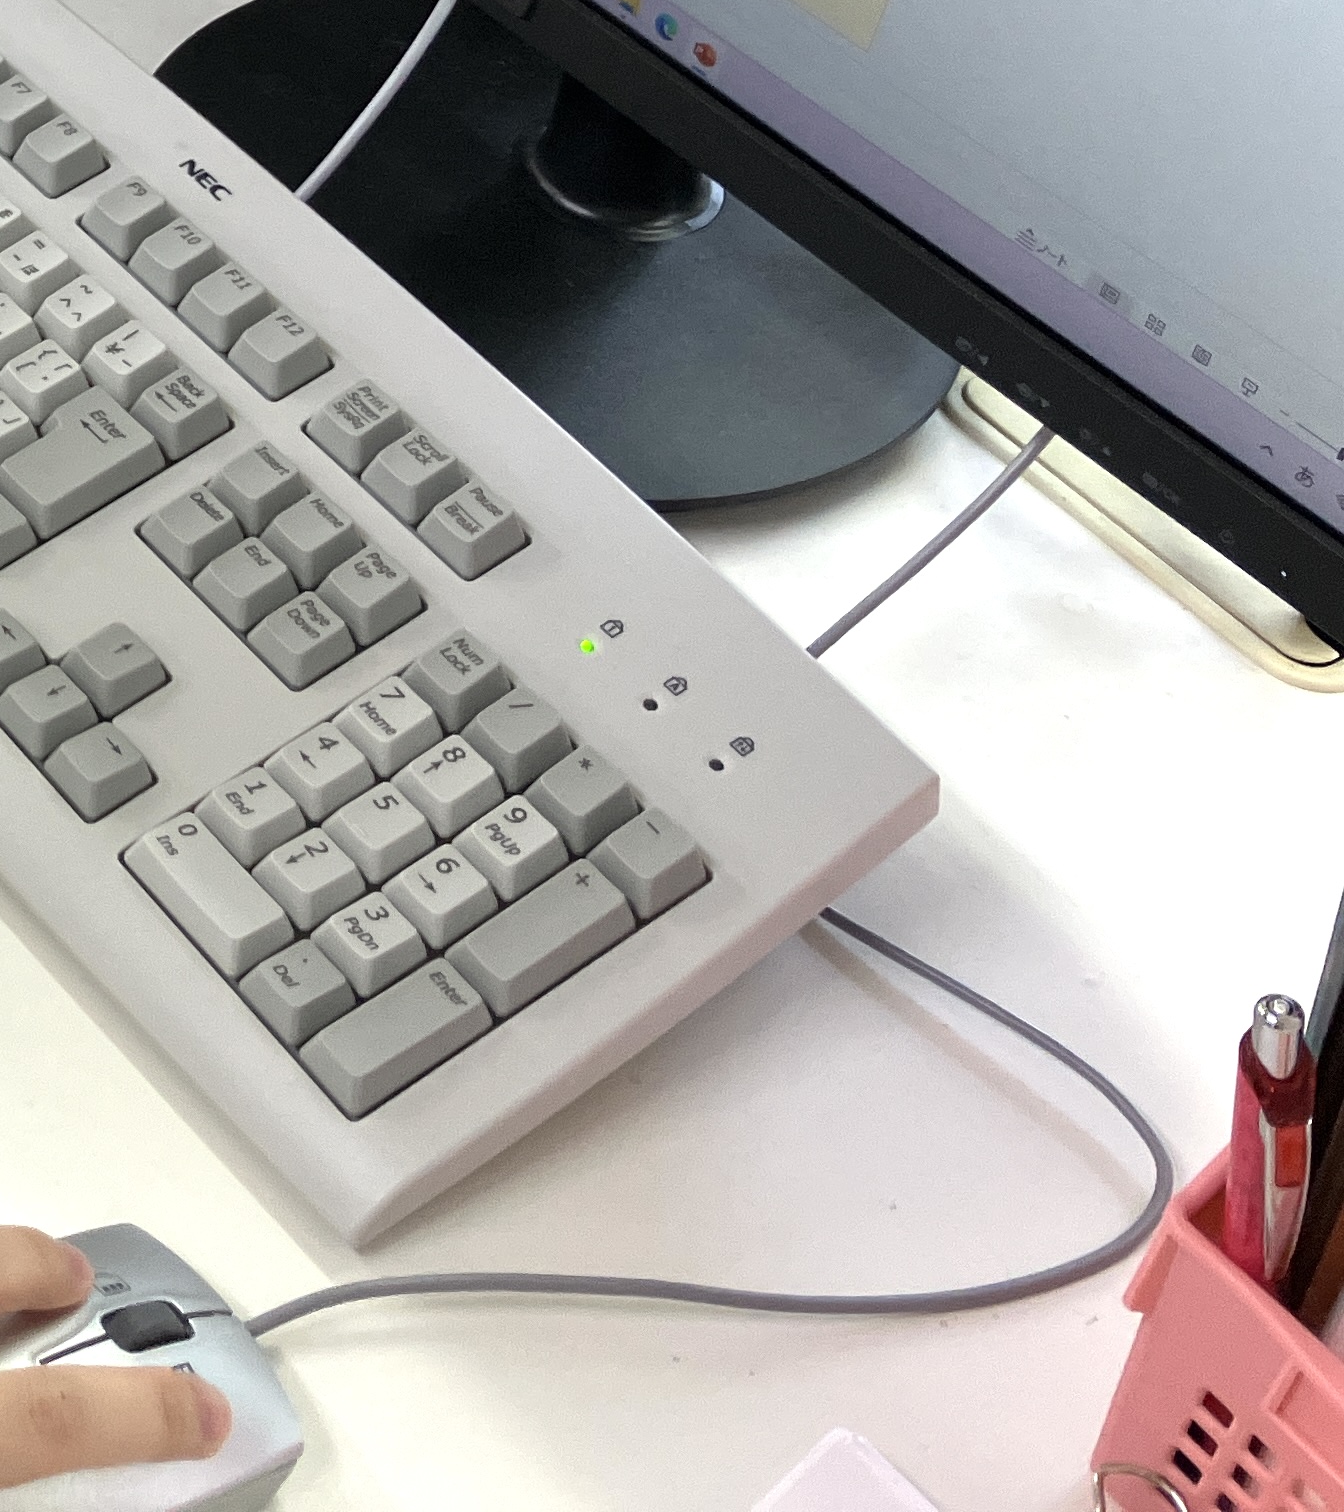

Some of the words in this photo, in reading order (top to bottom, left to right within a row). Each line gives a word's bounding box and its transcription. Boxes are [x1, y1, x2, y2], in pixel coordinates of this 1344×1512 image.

[11, 81, 32, 95] F7
[57, 120, 78, 136] F8
[125, 181, 147, 198] F9
[179, 158, 232, 202] NEC
[174, 223, 202, 246] F10
[1037, 243, 1068, 268] ノート
[224, 268, 253, 290] F11
[275, 314, 305, 337] F12
[165, 382, 197, 409] Space
[177, 374, 206, 398] Back
[347, 391, 380, 420] Screen
[360, 387, 389, 412] Print
[89, 408, 127, 441] Enter
[402, 440, 432, 467] Lock
[413, 434, 449, 462] Scroll
[255, 446, 290, 476] Insert
[1294, 466, 1315, 488] あ
[189, 491, 225, 522] Delete
[310, 498, 344, 529] Home
[469, 488, 503, 517] Pause
[444, 504, 479, 535] Break
[244, 544, 271, 568] End
[366, 552, 397, 579] Page
[353, 561, 373, 579] Up
[287, 608, 321, 638] Down
[299, 598, 331, 627] Page
[440, 647, 471, 676] Lock
[453, 638, 484, 667] Num
[379, 686, 406, 699] 7
[360, 701, 397, 736] Home
[318, 736, 339, 751] 4
[441, 746, 466, 763] 8
[244, 780, 267, 795] 1
[225, 791, 255, 816] End
[372, 794, 400, 811] 5
[503, 807, 527, 823] 9
[177, 824, 198, 837] 0
[485, 824, 521, 856] PgUp
[156, 835, 179, 856] Ins
[304, 841, 329, 858] 2
[435, 857, 461, 874] 6
[363, 905, 390, 921] 3
[343, 916, 379, 951] PgDn
[272, 963, 300, 988] Del
[429, 971, 467, 1007] Enter
